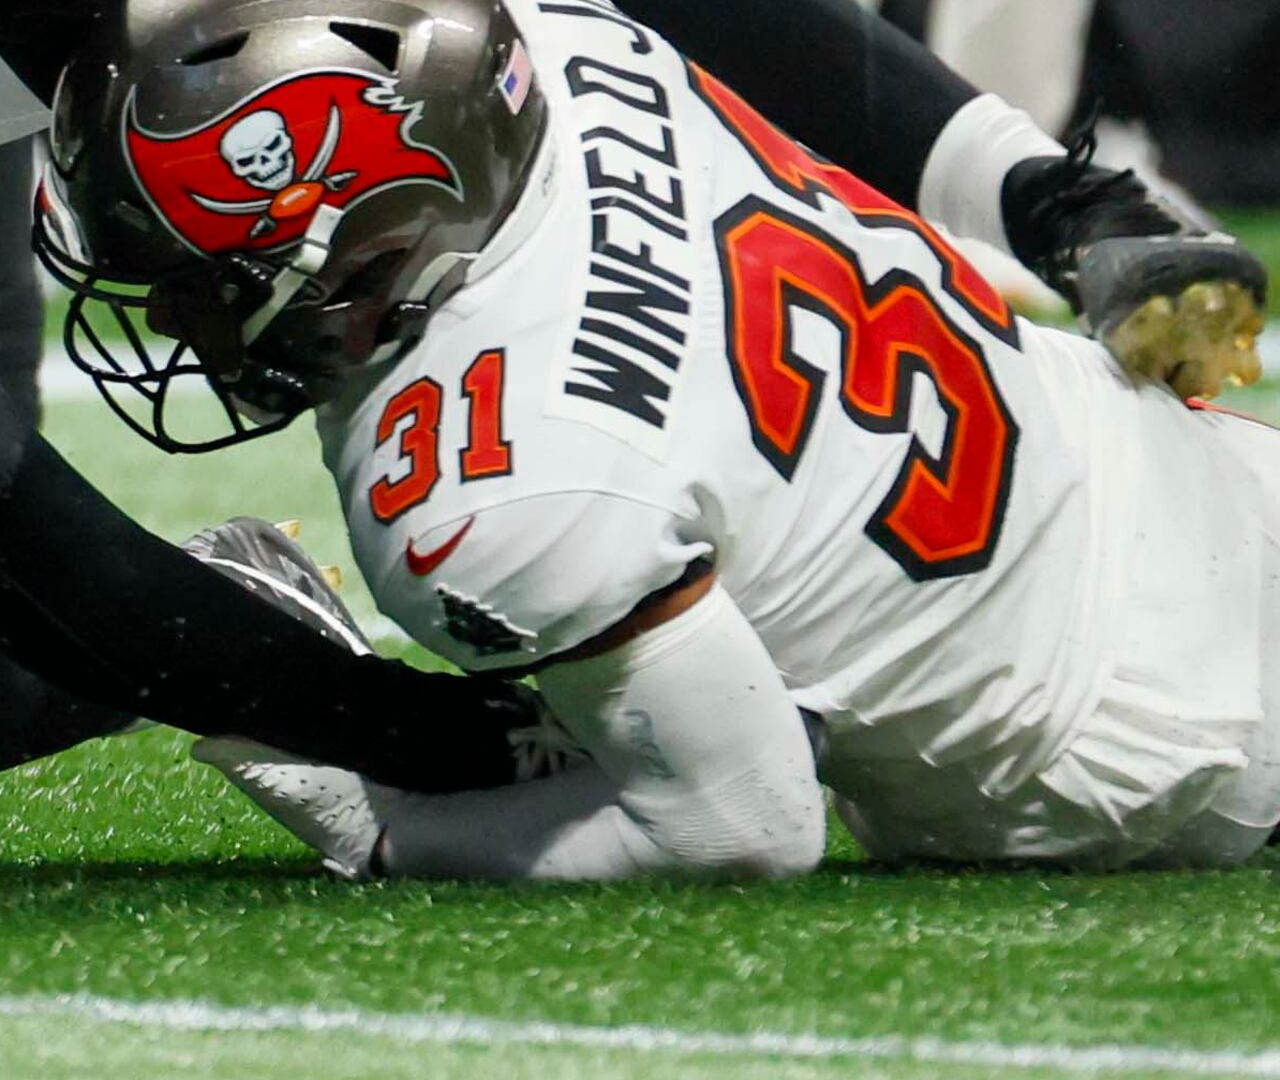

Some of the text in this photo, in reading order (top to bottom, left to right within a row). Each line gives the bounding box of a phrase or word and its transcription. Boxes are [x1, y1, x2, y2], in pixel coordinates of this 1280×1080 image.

[563, 55, 692, 430] WINFIELD
[683, 57, 1023, 583] 31
[368, 345, 515, 528] 31
